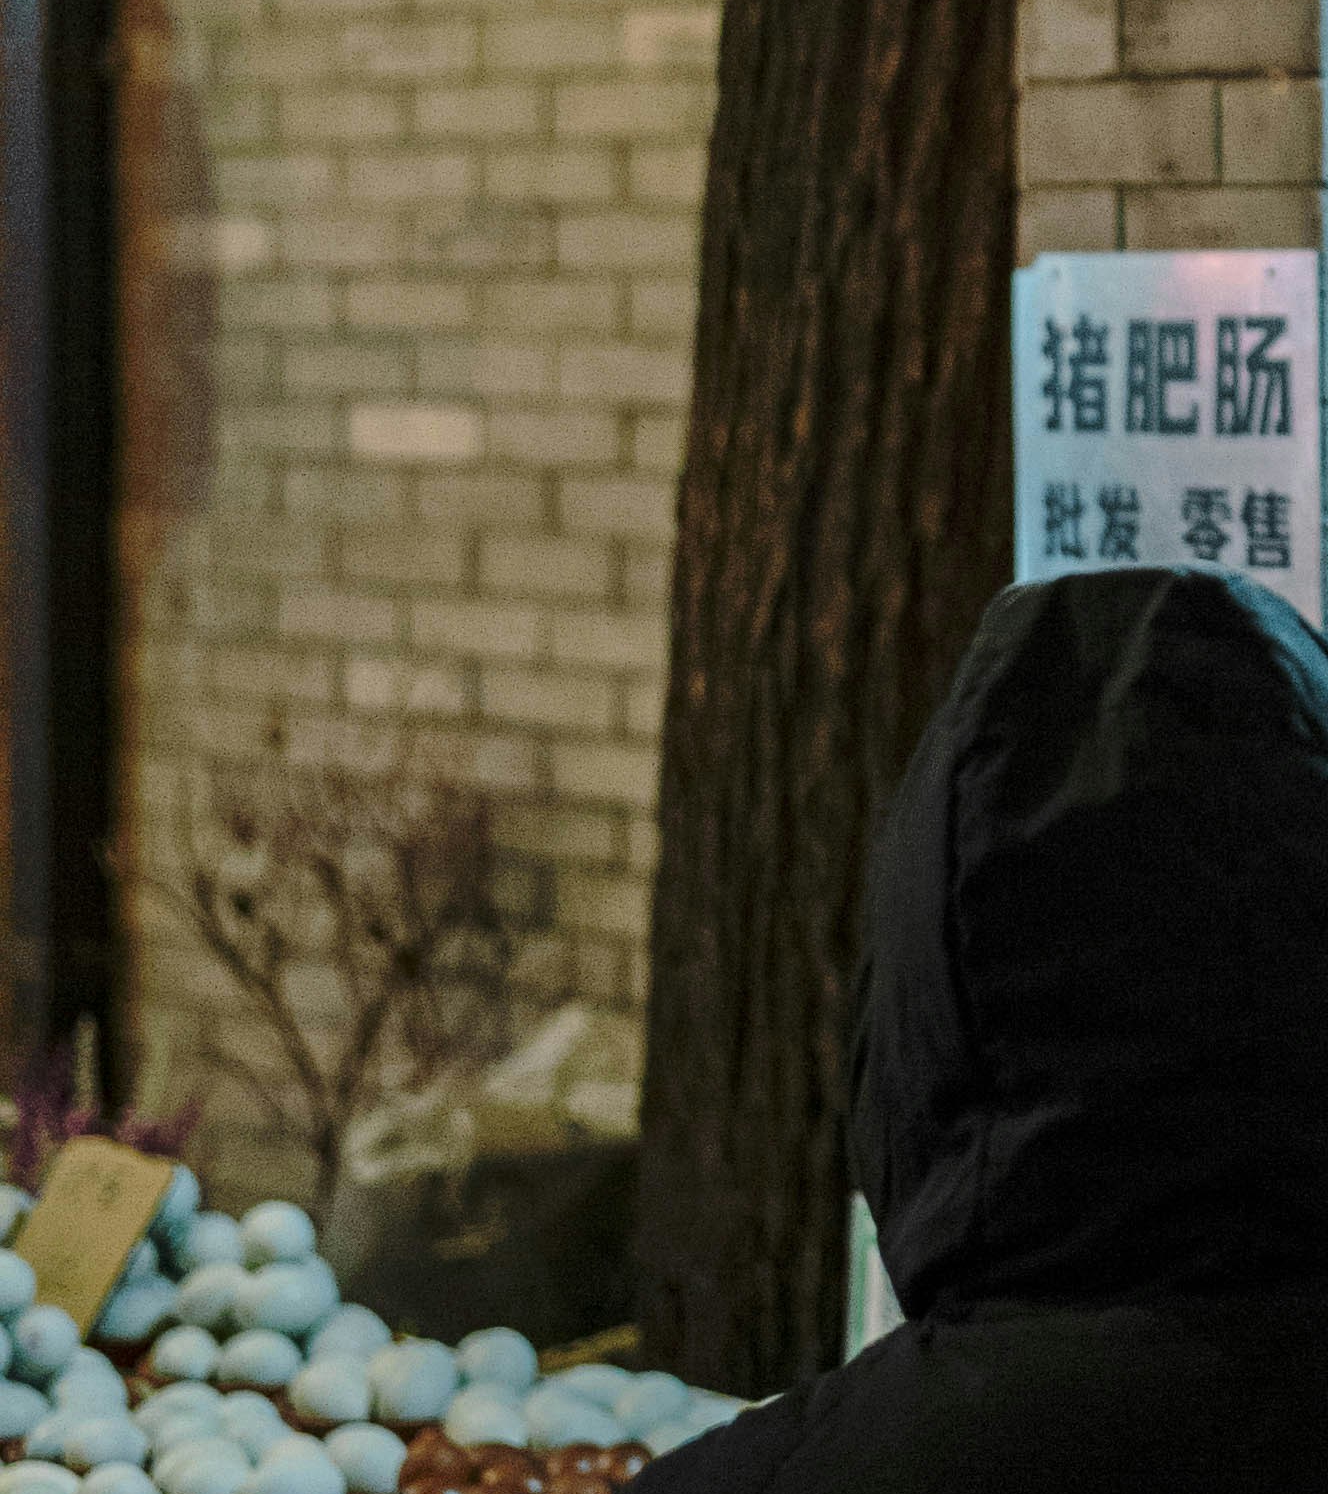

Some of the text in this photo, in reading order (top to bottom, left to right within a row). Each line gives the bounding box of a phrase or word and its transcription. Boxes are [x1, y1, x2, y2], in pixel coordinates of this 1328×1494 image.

[1042, 314, 1292, 436] 猪肥肠
[1044, 480, 1293, 569] 批发 零售
